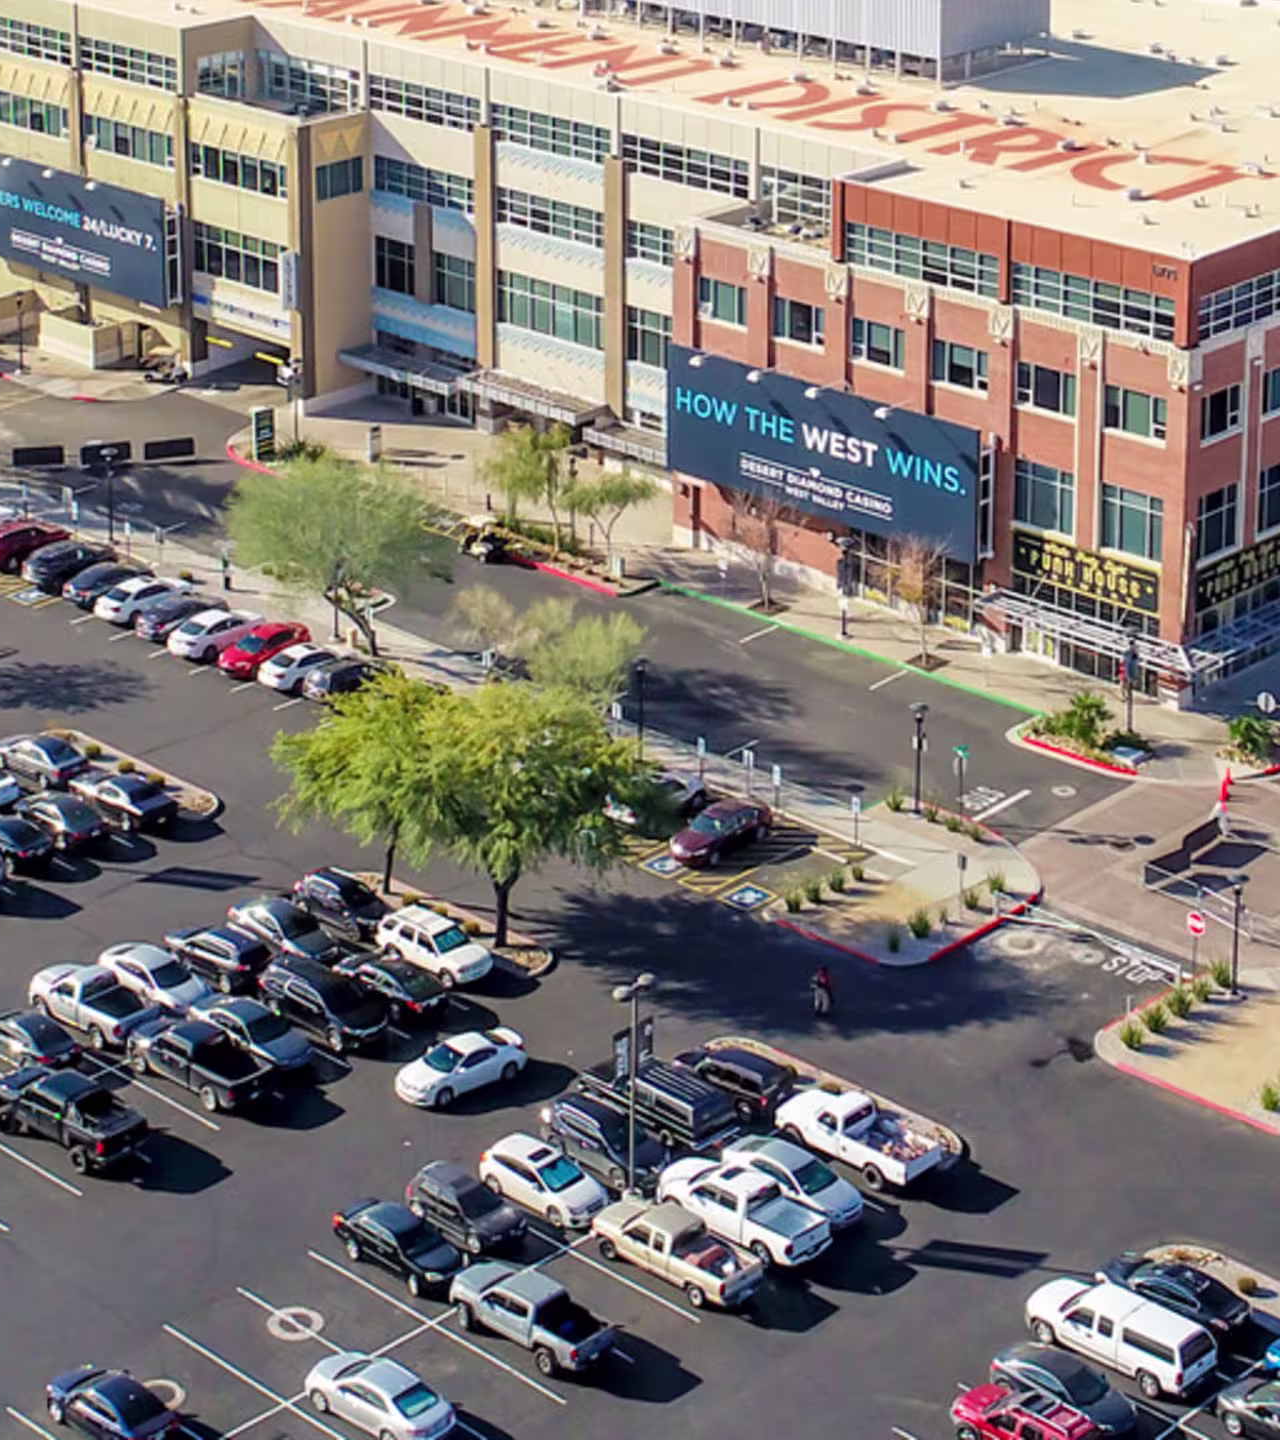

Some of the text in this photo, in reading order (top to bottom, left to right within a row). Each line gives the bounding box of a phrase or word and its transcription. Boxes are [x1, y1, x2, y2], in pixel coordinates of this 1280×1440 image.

[695, 77, 1278, 203] DISTRICT
[22, 197, 82, 229] WELCOME
[82, 215, 143, 247] 24/LUCKY
[675, 386, 967, 496] HOW THE WEST WINS.
[740, 456, 893, 515] DESERT DIAMOND CASINO
[785, 485, 846, 512] WEST VALLEY
[1101, 955, 1166, 985] STOP
